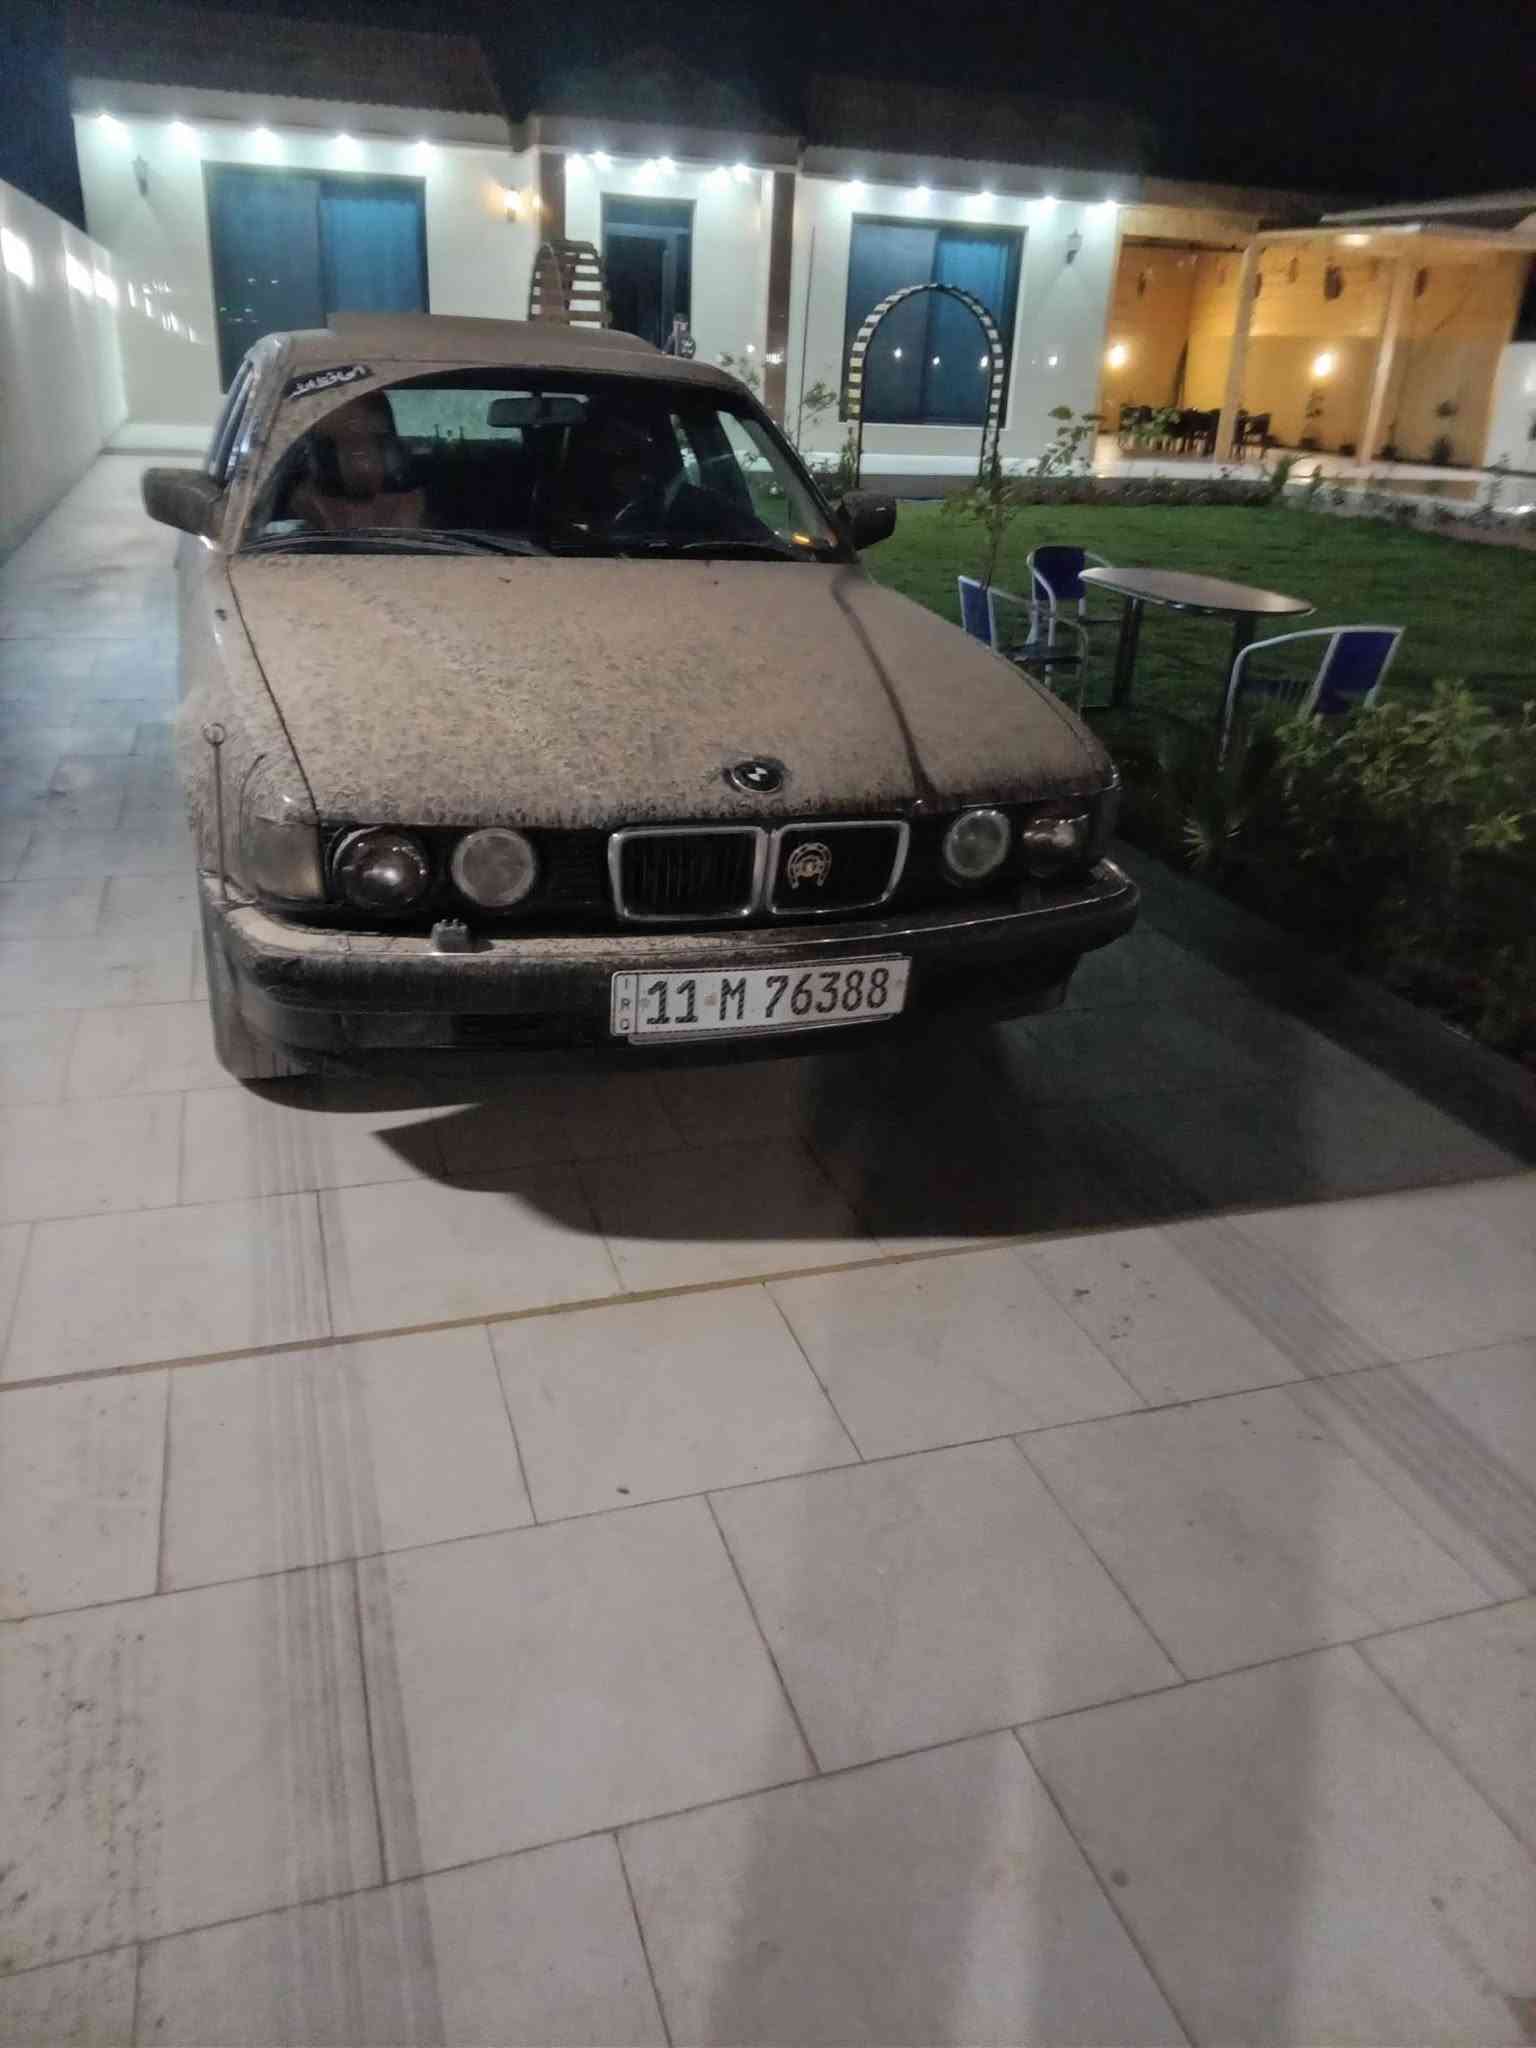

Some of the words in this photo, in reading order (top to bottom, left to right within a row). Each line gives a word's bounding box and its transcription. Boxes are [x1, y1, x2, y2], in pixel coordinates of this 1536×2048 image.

[647, 980, 698, 1024] 11
[719, 978, 747, 1020] M
[766, 967, 889, 1018] 76388
